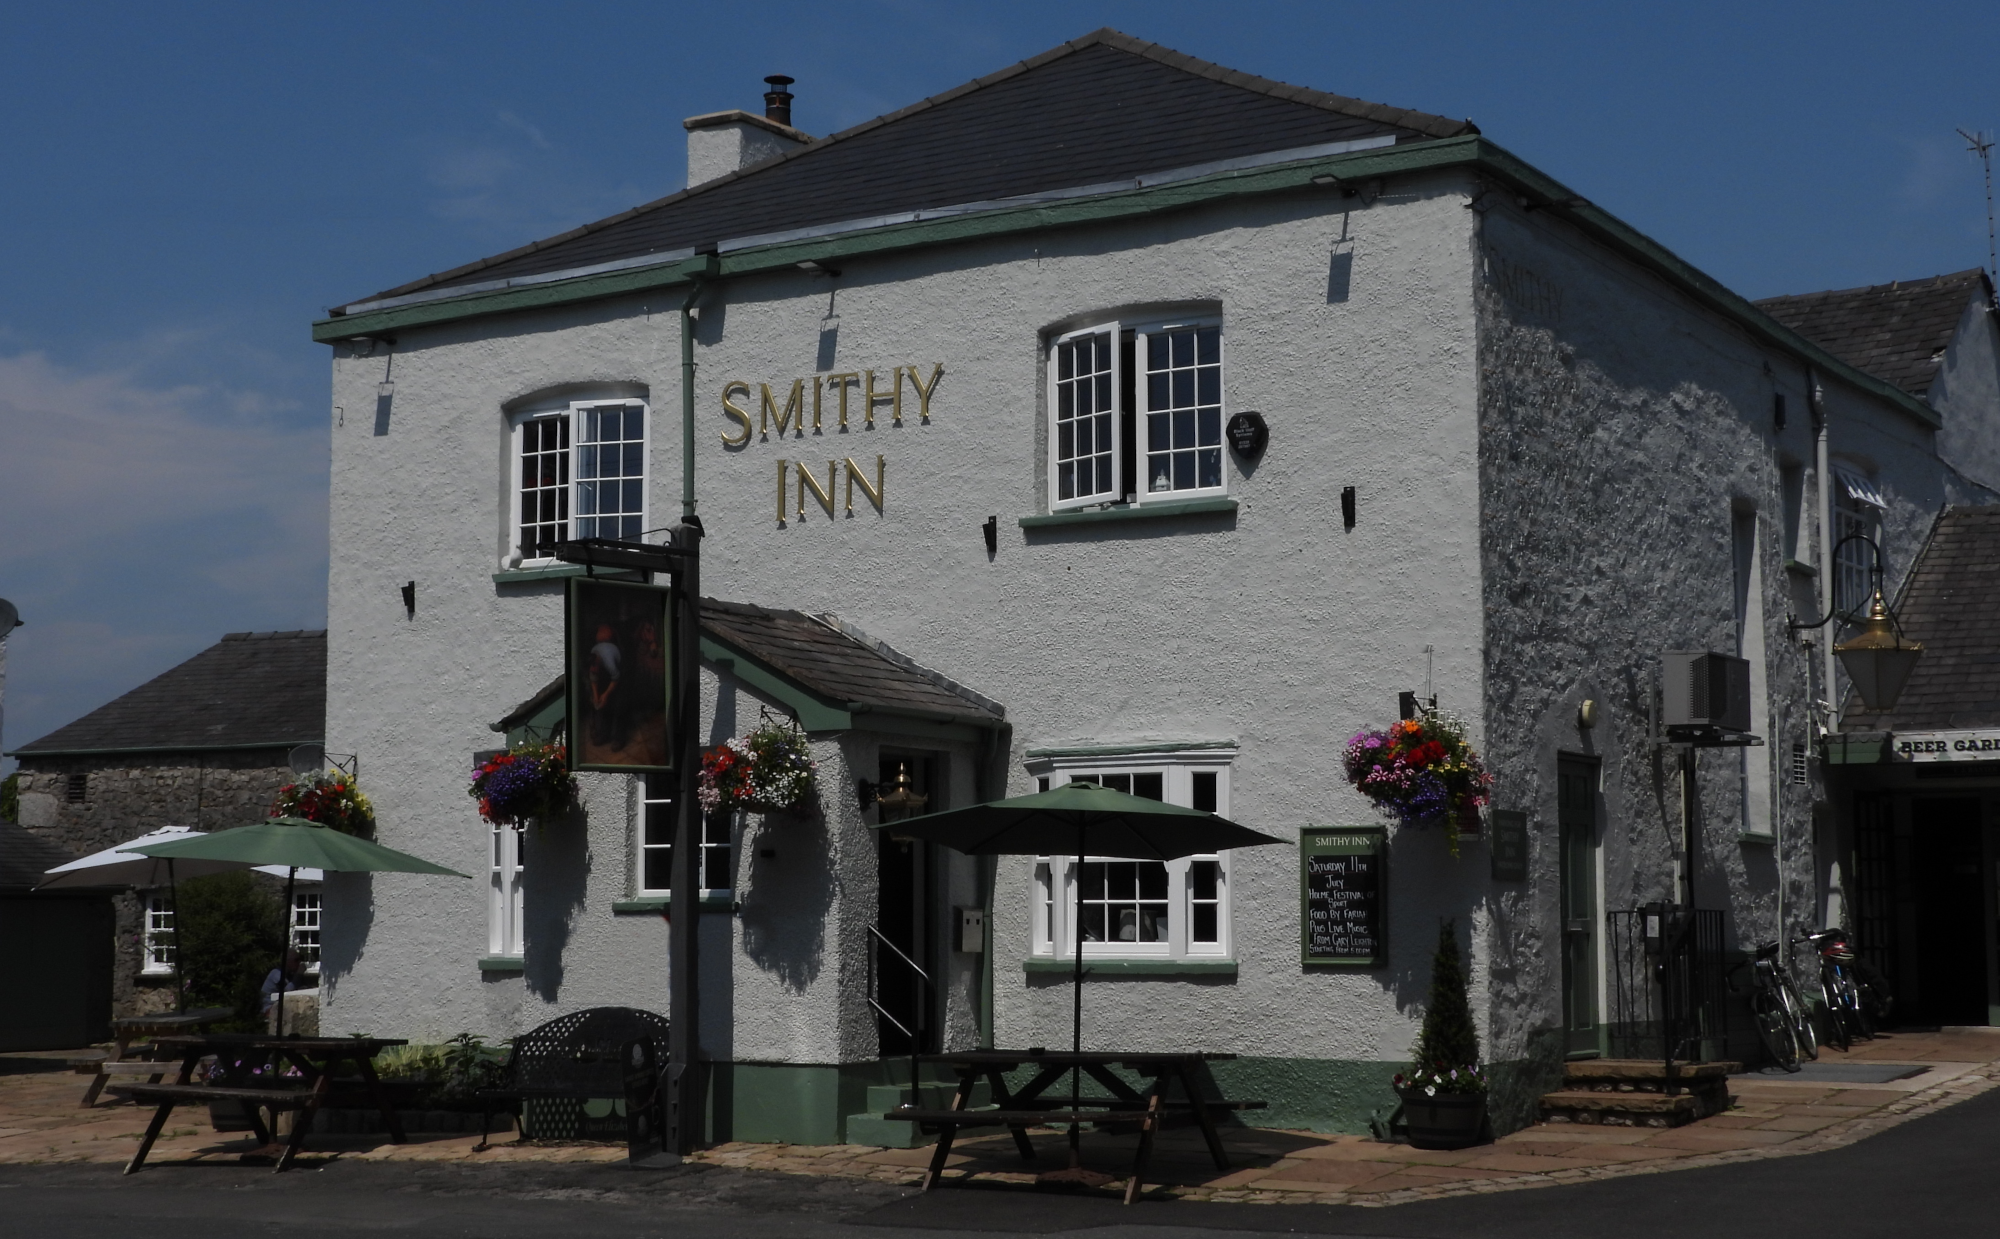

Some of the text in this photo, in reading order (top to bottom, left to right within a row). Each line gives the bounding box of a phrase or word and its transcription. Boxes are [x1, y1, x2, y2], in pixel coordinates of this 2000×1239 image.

[720, 362, 943, 443] SMITHY
[776, 454, 884, 521] INN
[1900, 741, 1947, 753] BEER
[1315, 836, 1370, 846] SMITHY INN
[1308, 855, 1367, 876] SATURDAY 11TH
[1324, 874, 1344, 889] JULY
[1308, 888, 1376, 900] HOLME FESTIVAL OF
[1328, 898, 1347, 909] SPORT
[1309, 907, 1327, 920] FOOD
[1330, 909, 1341, 921] BY
[1309, 920, 1368, 934] PLUS LIVE MUSIC
[1313, 933, 1331, 945] FROM
